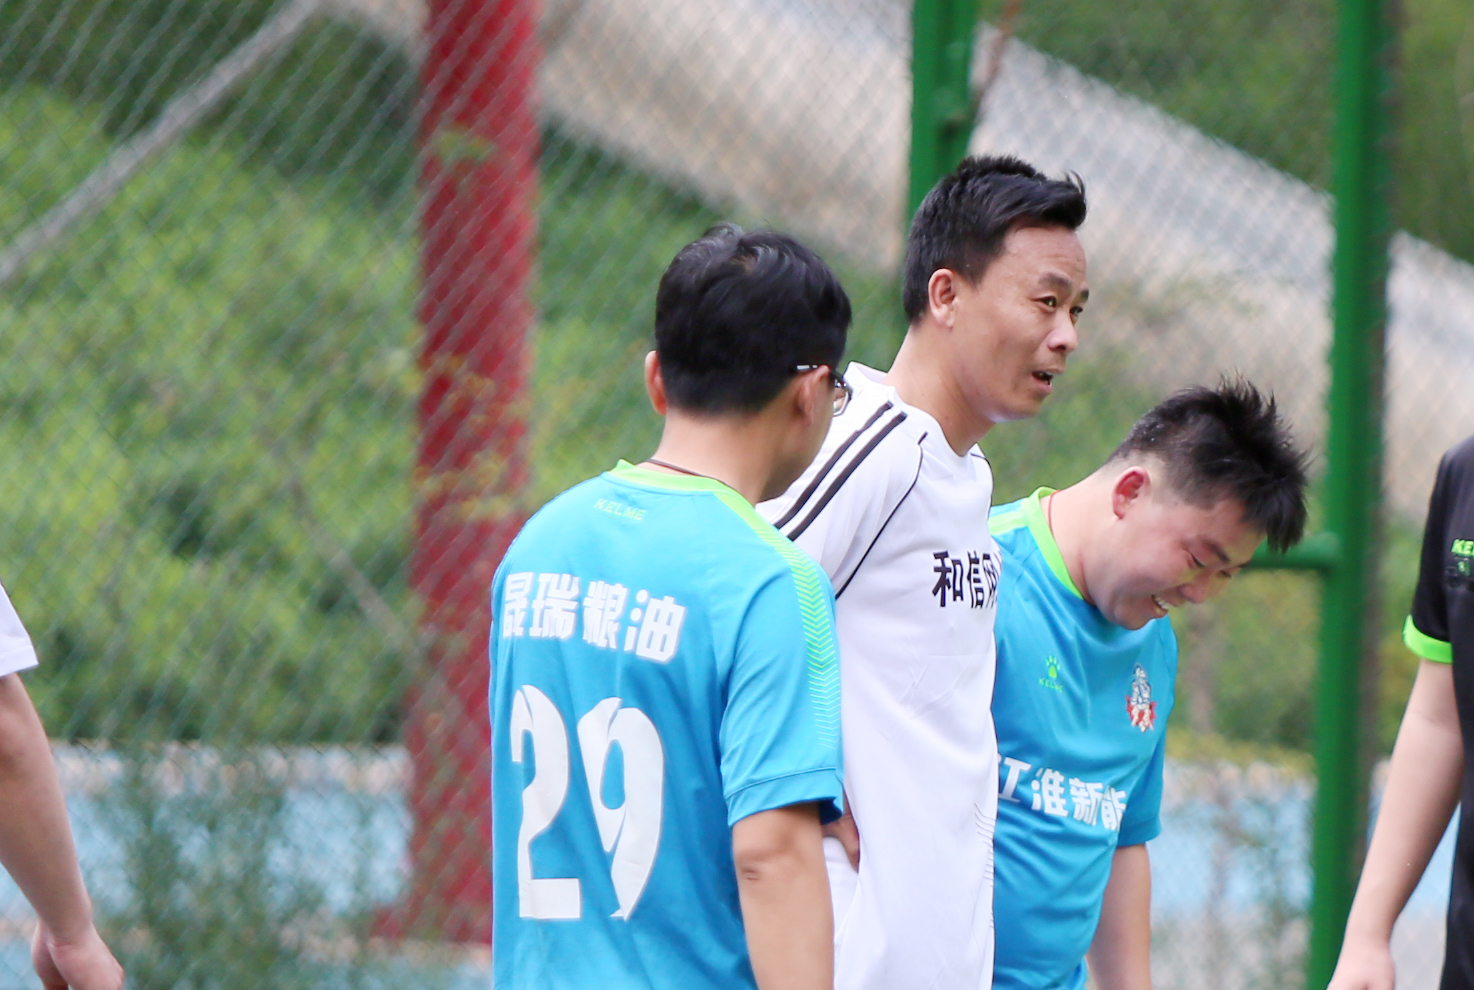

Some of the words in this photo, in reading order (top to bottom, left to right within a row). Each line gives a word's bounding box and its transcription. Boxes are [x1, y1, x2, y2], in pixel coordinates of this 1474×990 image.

[503, 571, 686, 663] 晟瑞粮油
[510, 684, 664, 922] 29
